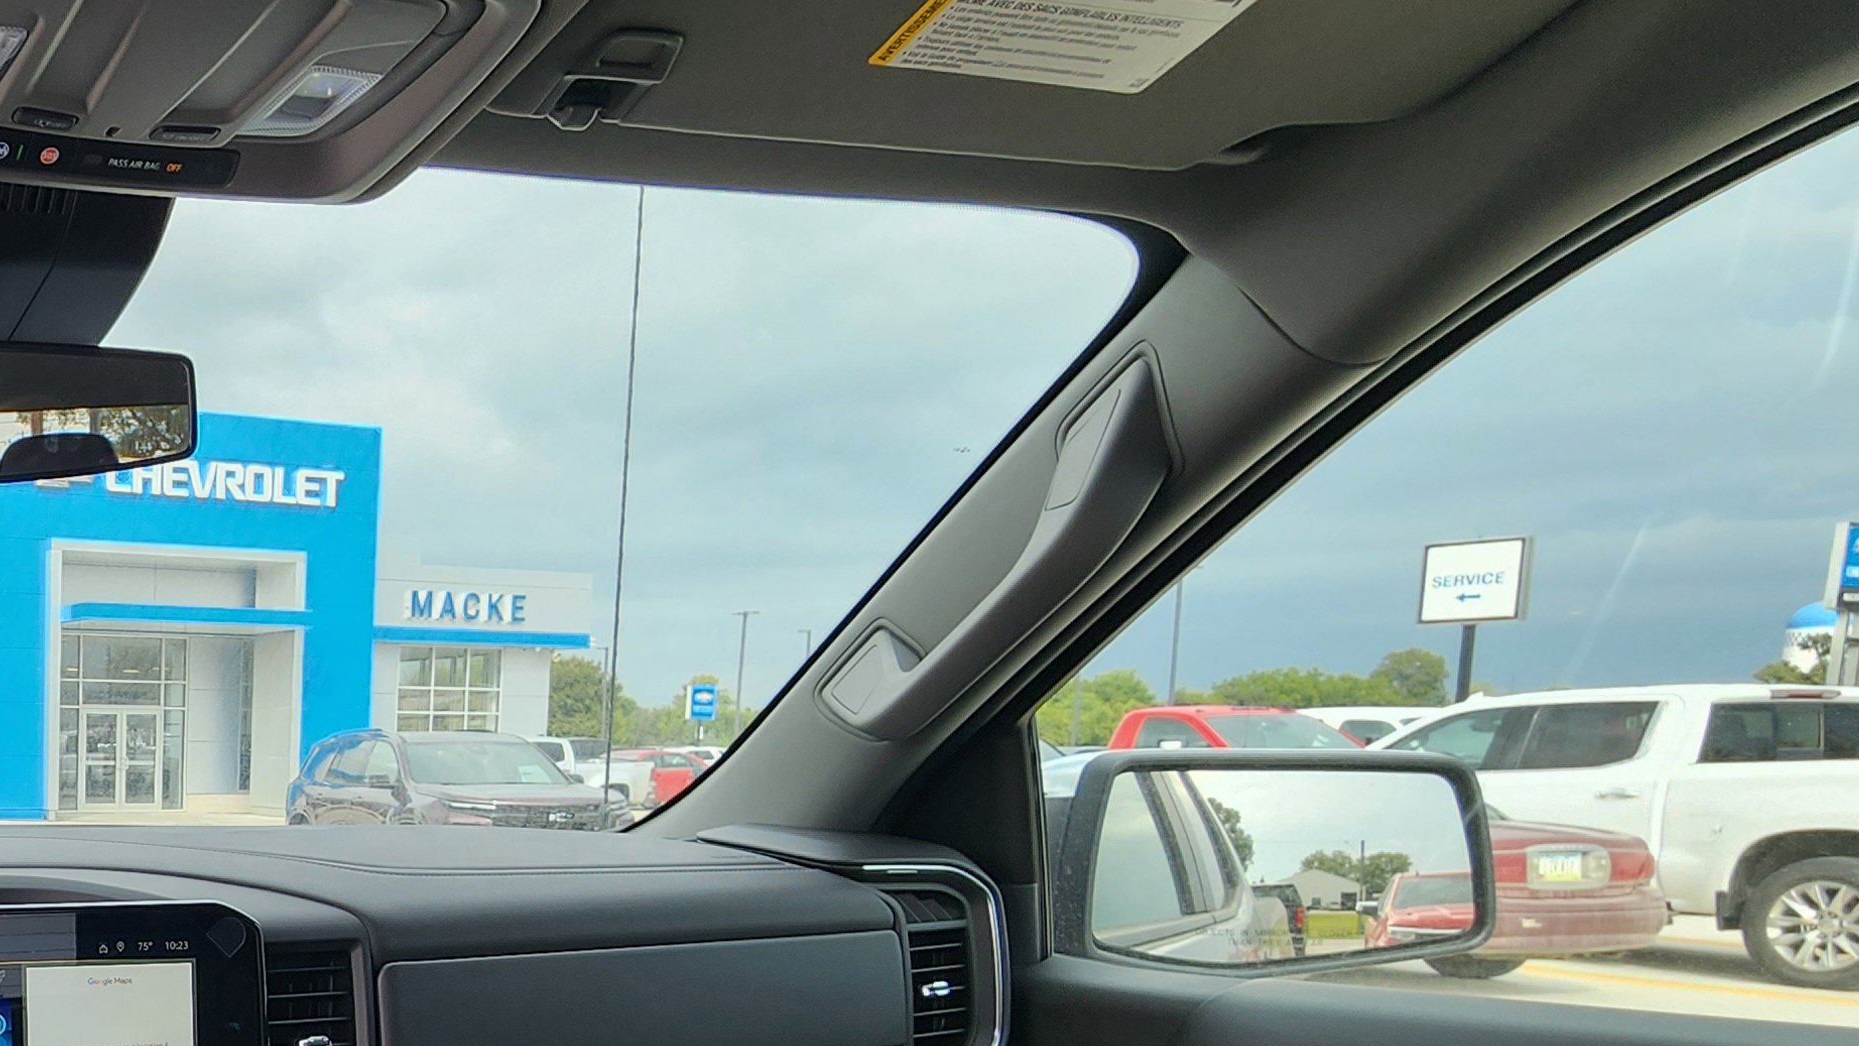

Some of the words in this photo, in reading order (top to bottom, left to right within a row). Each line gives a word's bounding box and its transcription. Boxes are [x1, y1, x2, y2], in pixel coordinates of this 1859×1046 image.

[108, 158, 129, 168] PASS
[129, 160, 143, 169] AIR
[144, 161, 160, 170] BAG
[166, 163, 182, 172] OFF
[105, 459, 345, 507] CHEVROLET
[1432, 571, 1505, 588] SERVICE
[410, 590, 527, 622] MACKE
[137, 941, 154, 951] 75°
[165, 941, 189, 951] 10:23
[87, 977, 112, 986] Google
[114, 977, 132, 985] Maps
